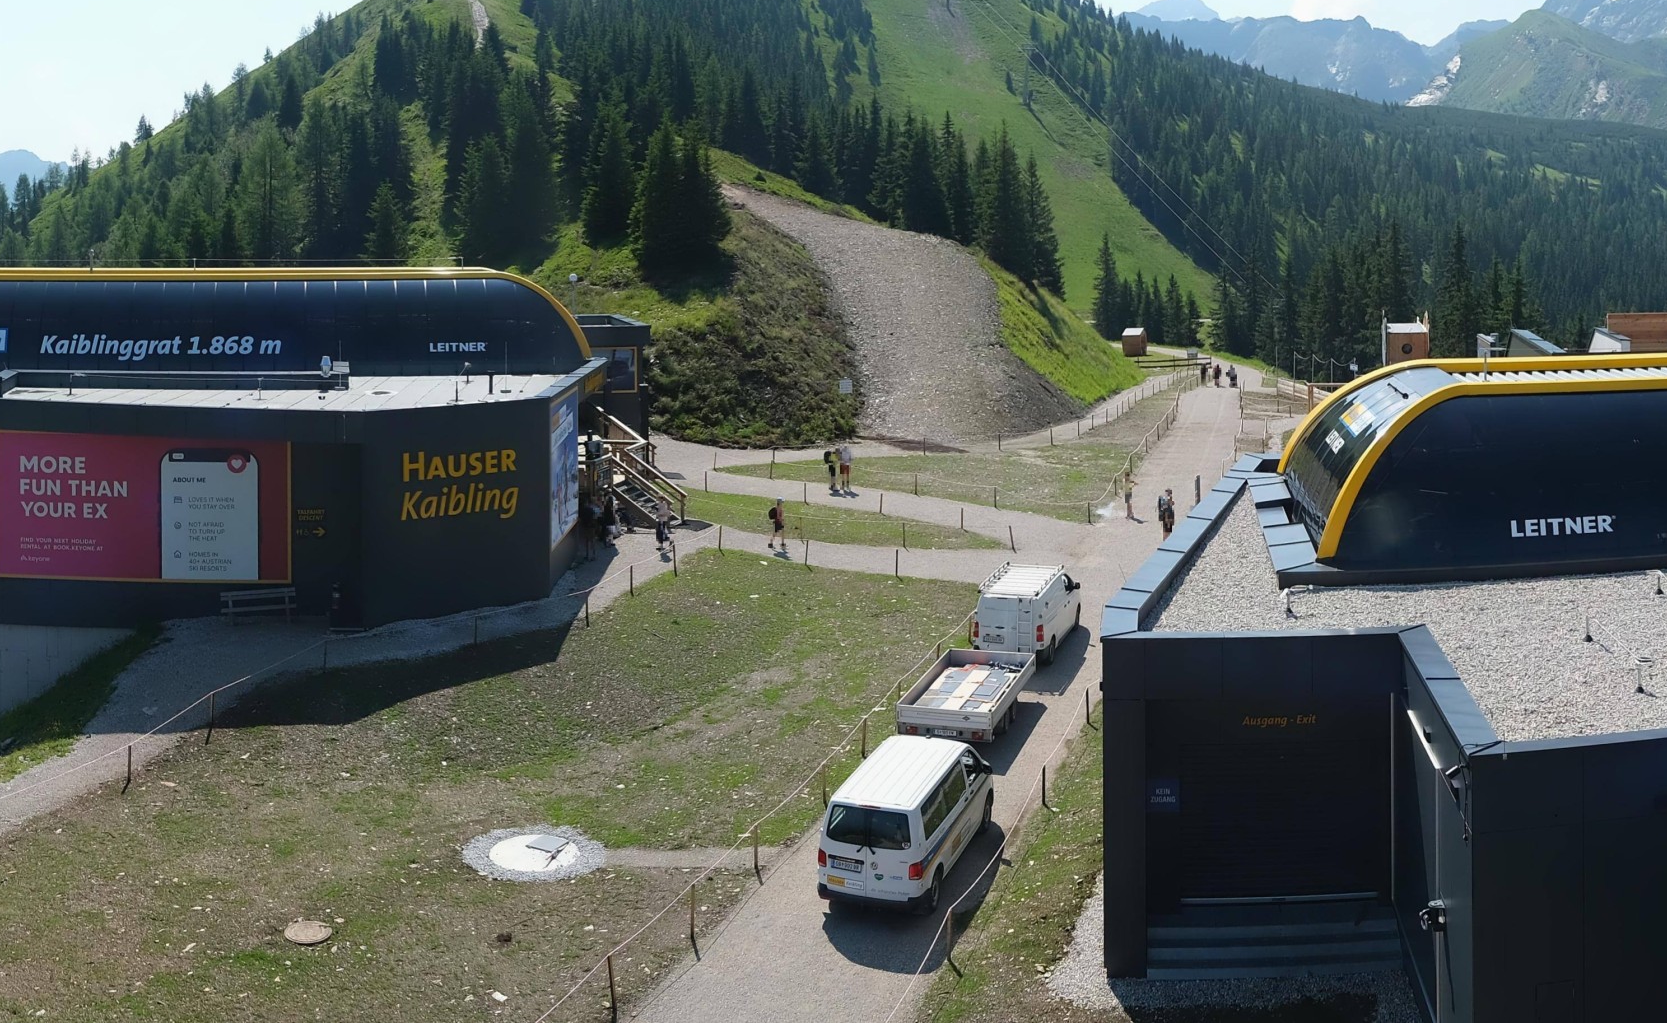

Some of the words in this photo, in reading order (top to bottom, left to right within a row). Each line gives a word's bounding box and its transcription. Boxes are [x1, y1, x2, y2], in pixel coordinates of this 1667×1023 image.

[40, 334, 182, 361] Kaiblinggrat
[187, 336, 254, 355] 1.868
[259, 339, 282, 355] m
[428, 341, 488, 353] LEITNER
[20, 456, 86, 474] MORE
[402, 449, 517, 482] HAUSER
[20, 478, 61, 496] FUN
[68, 480, 128, 497] THAN
[20, 501, 76, 518] YOUR
[83, 503, 108, 518] EX
[400, 483, 519, 522] Kaibling
[1510, 515, 1615, 537] LEITNER
[1242, 716, 1288, 728] Ausgang
[1296, 714, 1316, 724] Exit
[1150, 795, 1176, 803] ZUGANG
